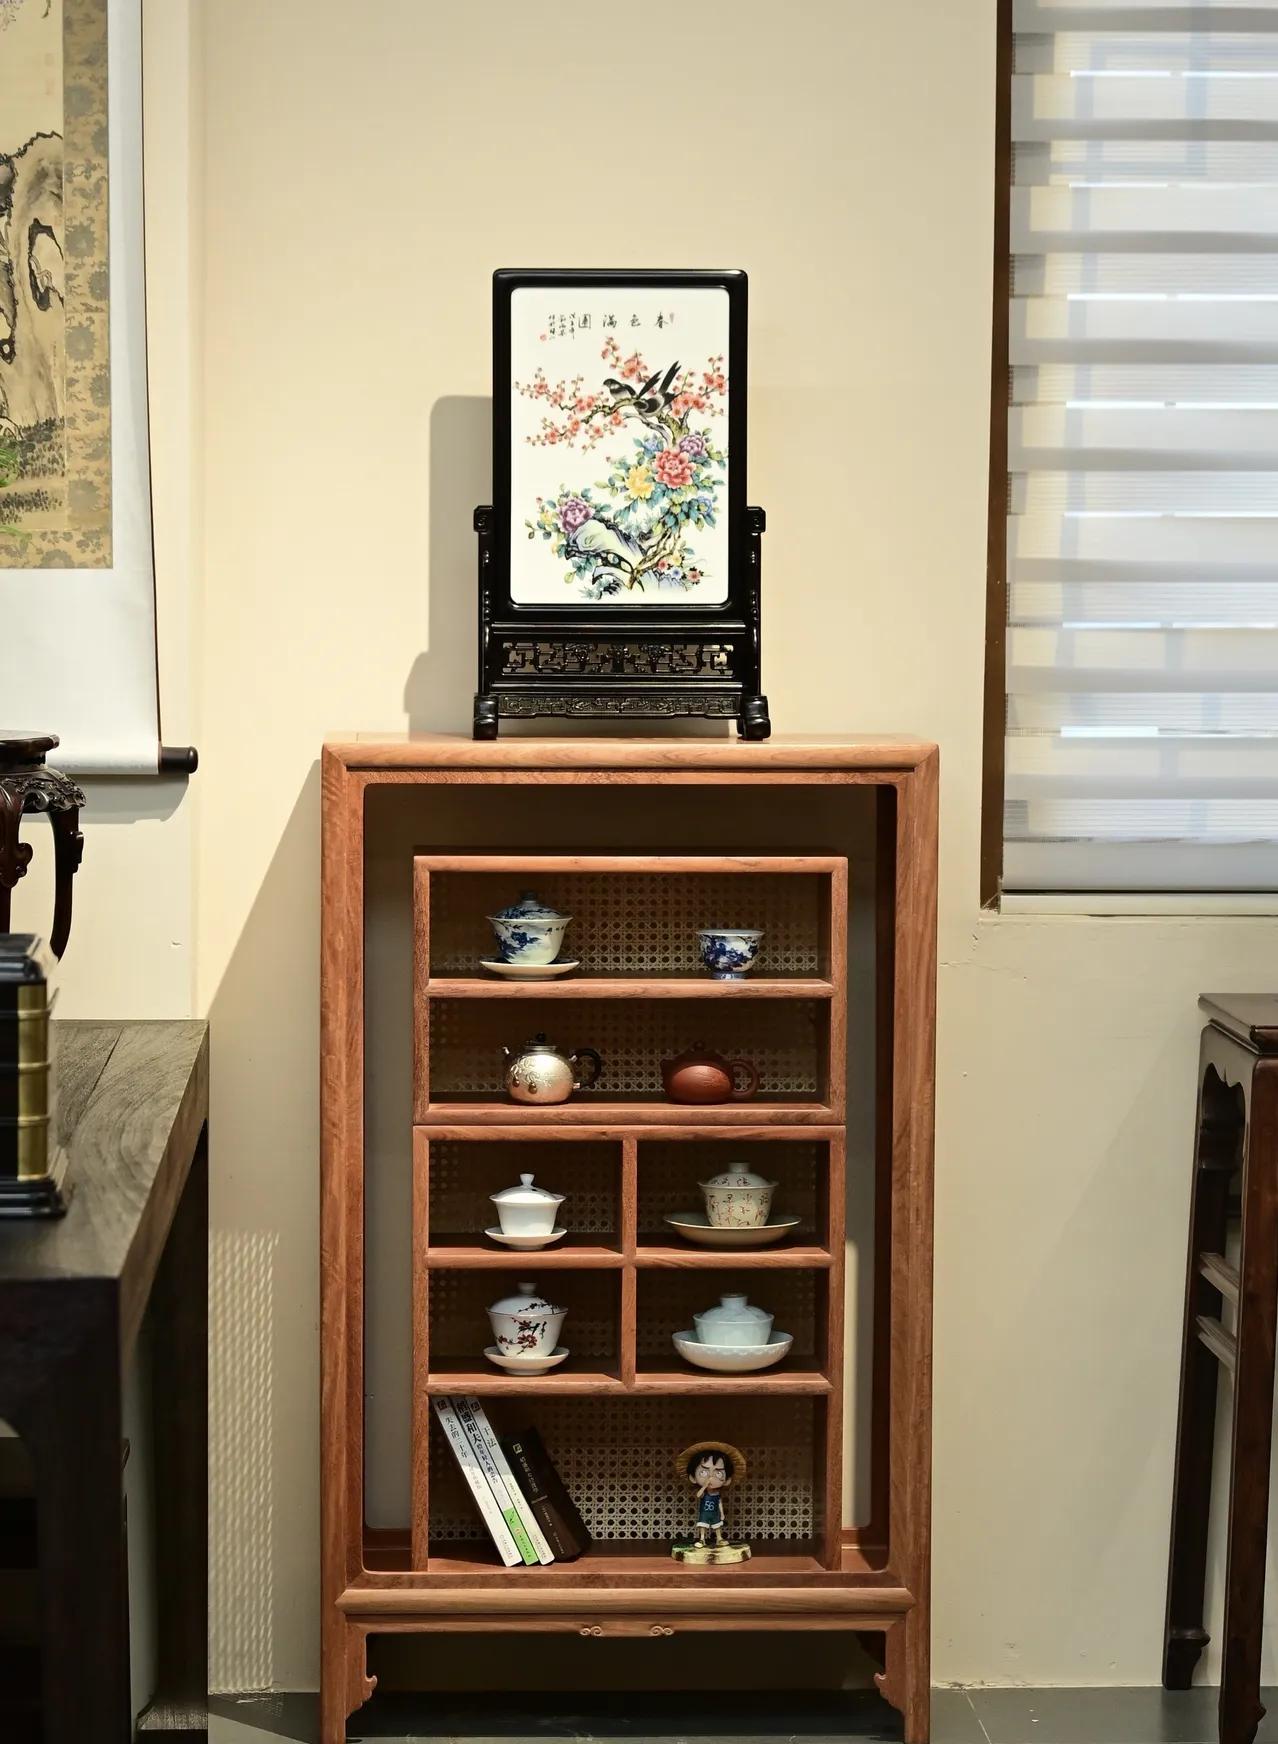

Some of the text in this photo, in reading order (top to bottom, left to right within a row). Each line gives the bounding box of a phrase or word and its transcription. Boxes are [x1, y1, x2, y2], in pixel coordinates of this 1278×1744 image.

[456, 1400, 481, 1443] 稻盛和夫
[703, 1500, 715, 1511] 56
